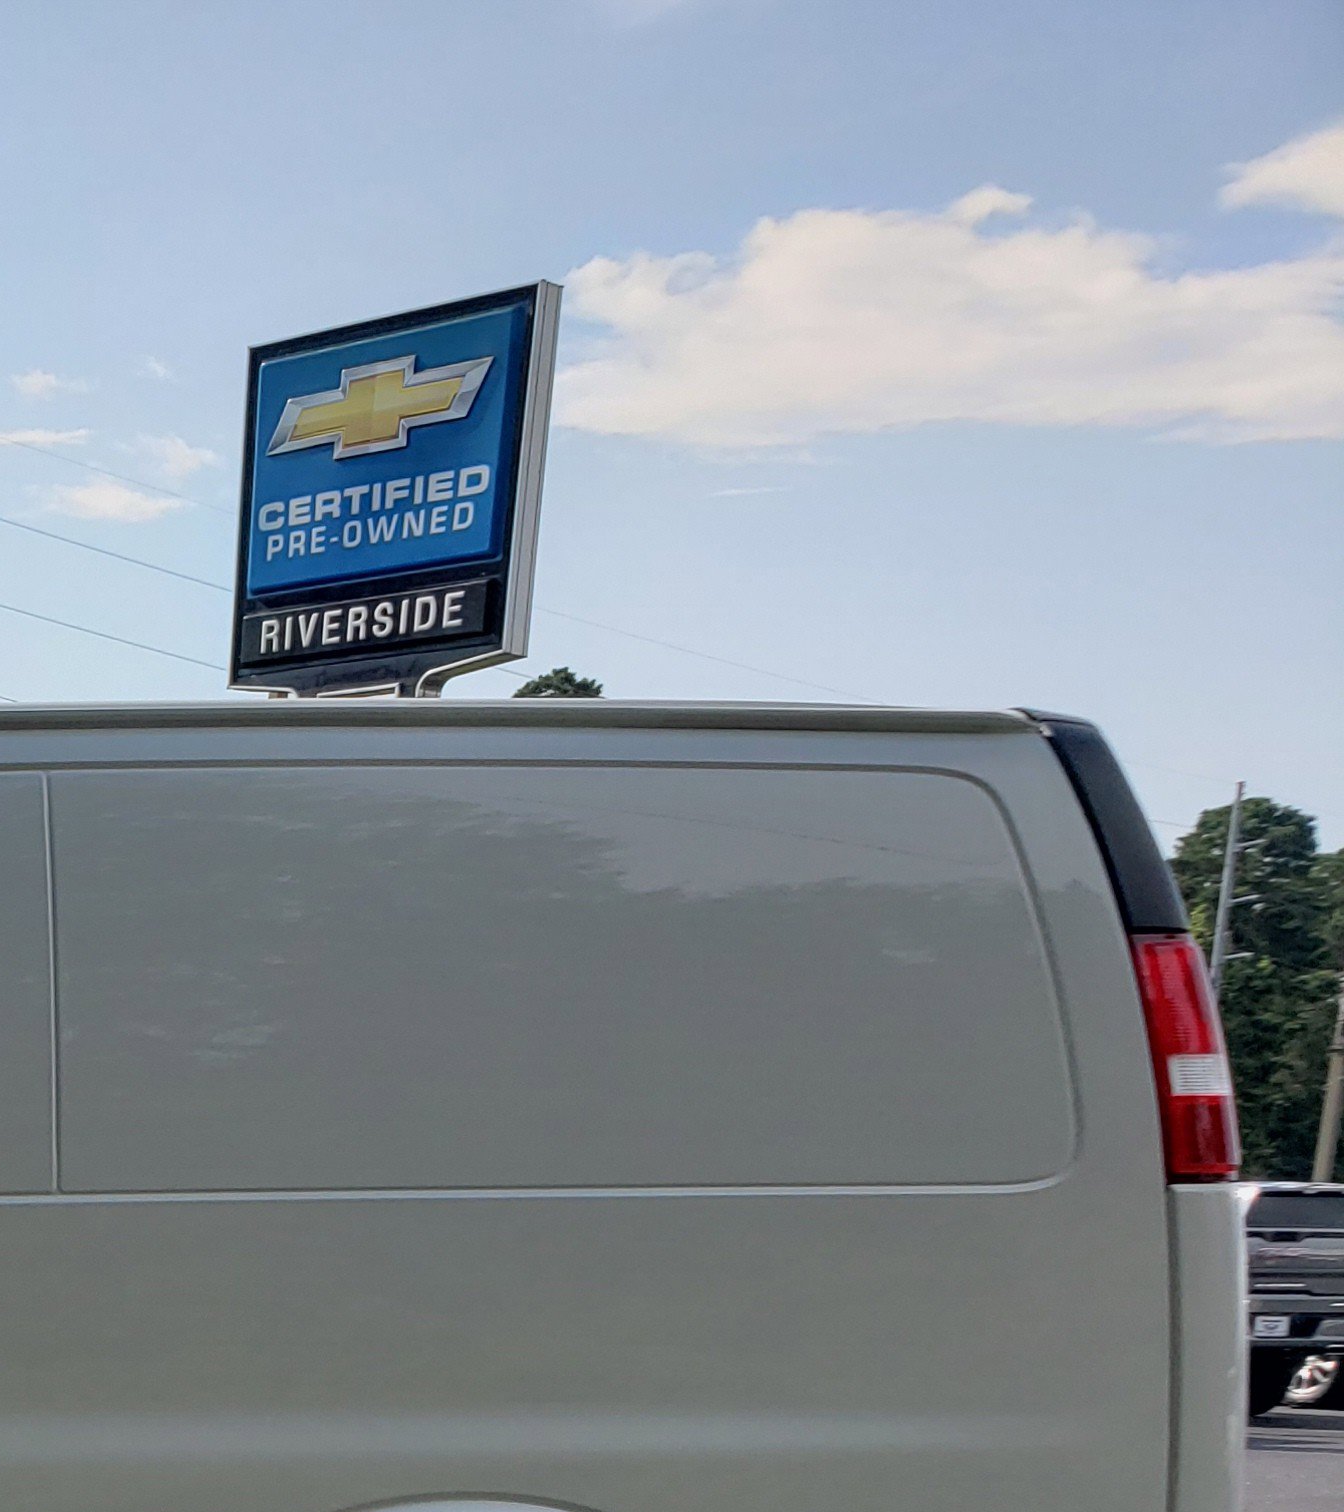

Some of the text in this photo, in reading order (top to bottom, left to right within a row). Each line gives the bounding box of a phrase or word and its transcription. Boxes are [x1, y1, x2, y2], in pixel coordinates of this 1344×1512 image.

[258, 464, 491, 532] CERTIFIED
[266, 501, 475, 561] PRE-OWNED
[260, 590, 466, 654] RIVERSIDE
